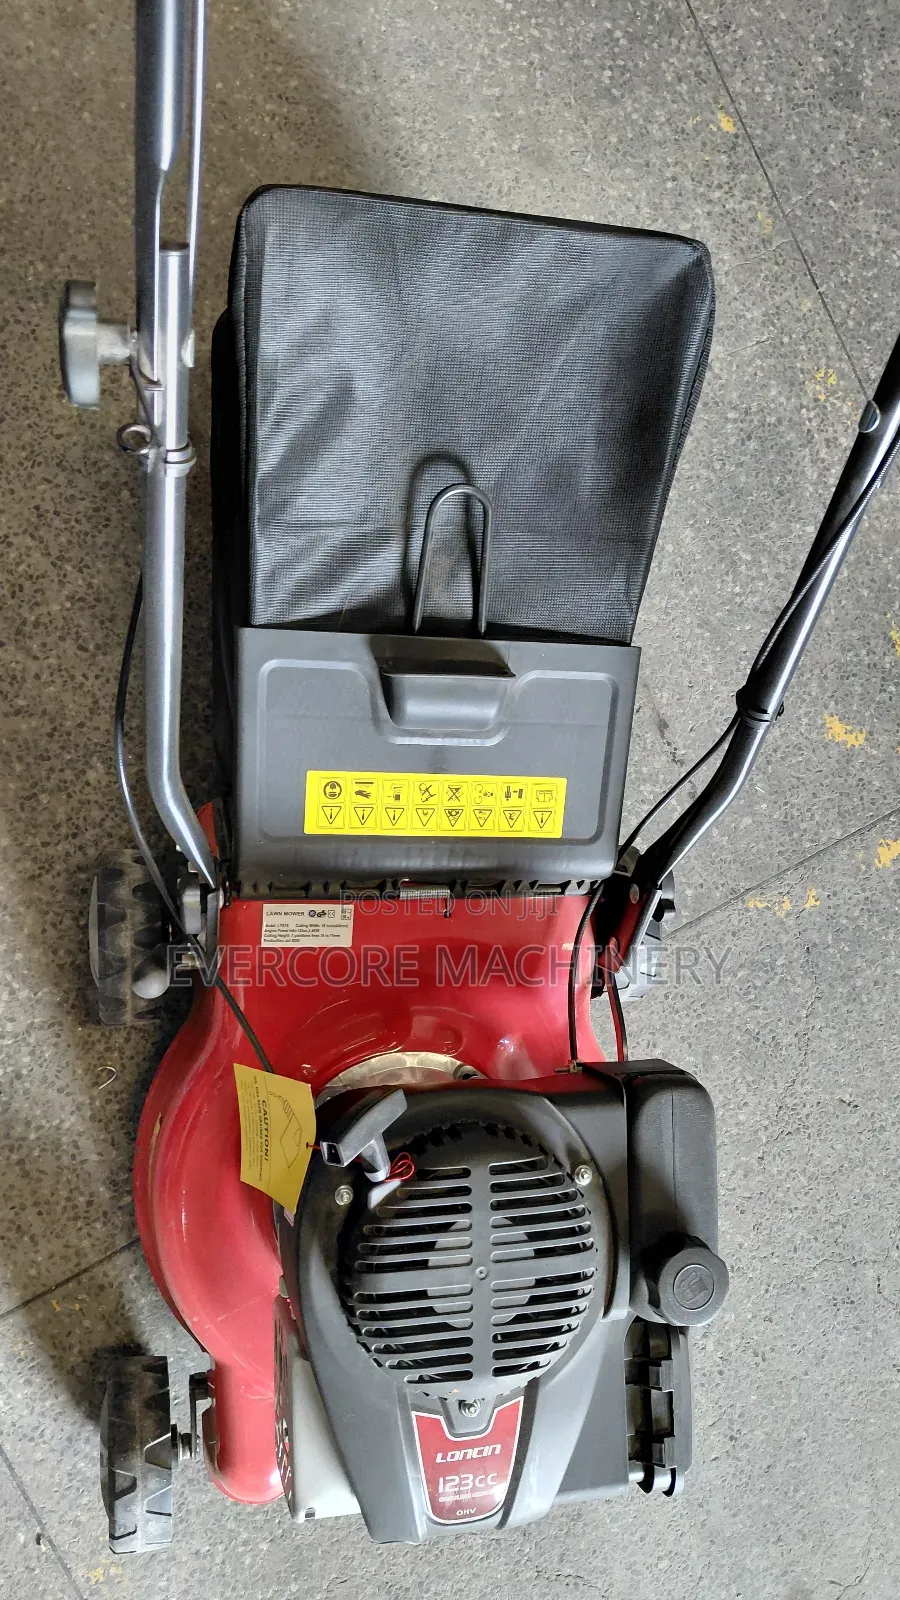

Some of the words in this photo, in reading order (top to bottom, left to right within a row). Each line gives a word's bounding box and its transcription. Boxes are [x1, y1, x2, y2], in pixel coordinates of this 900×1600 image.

[261, 1099, 270, 1162] CAUTION!
[435, 1443, 502, 1464] LONCIN
[456, 1508, 477, 1516] OHV
